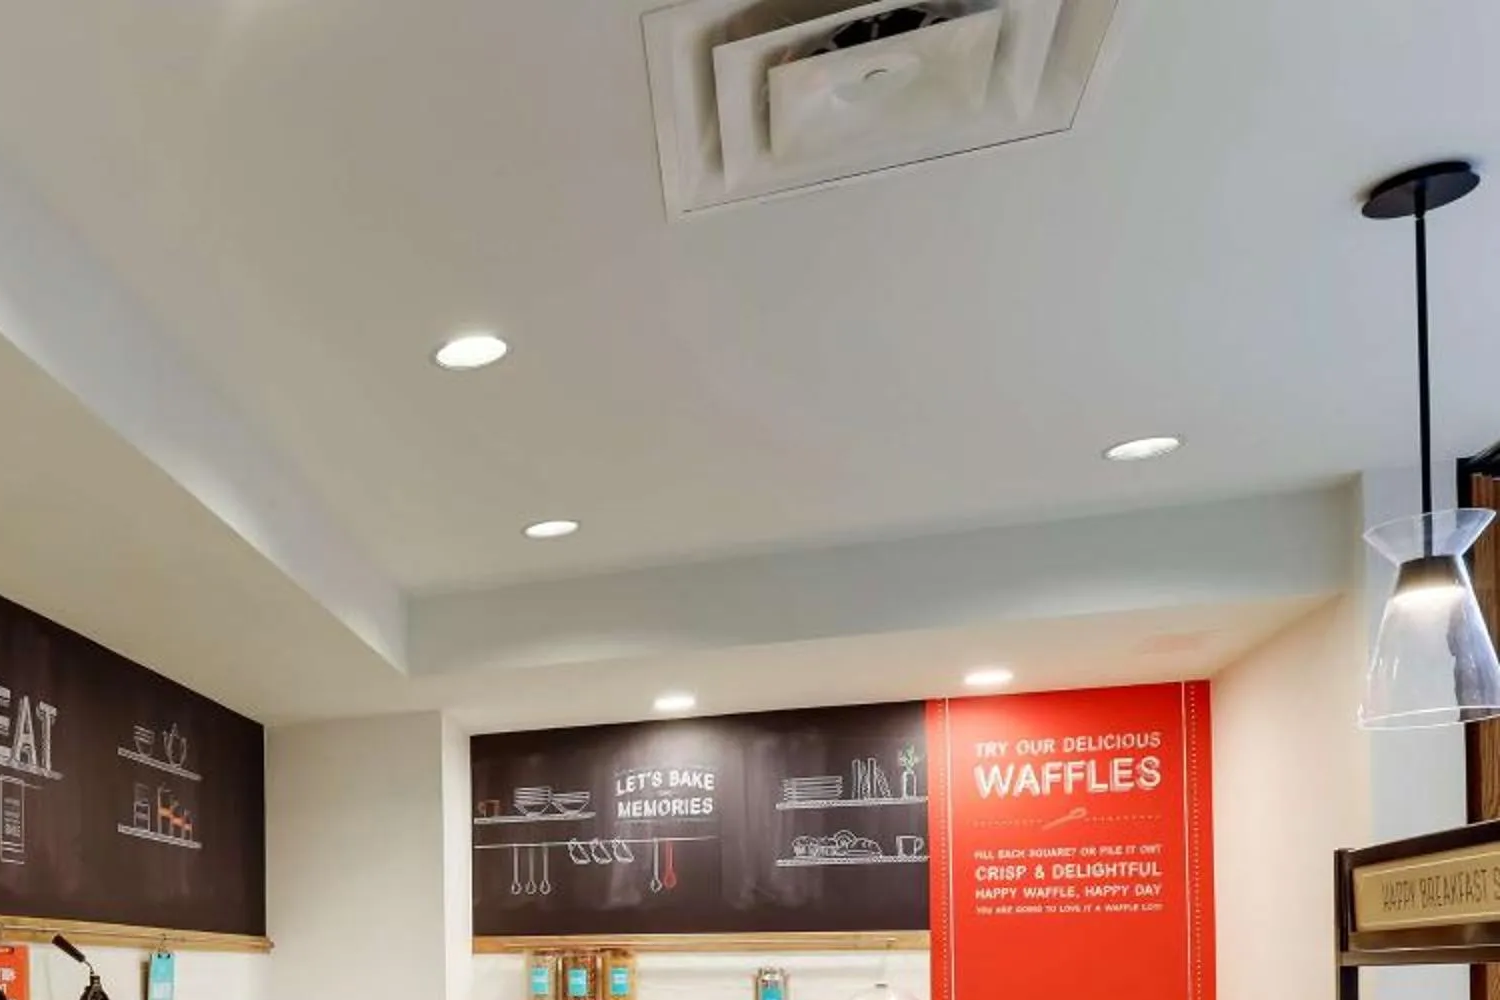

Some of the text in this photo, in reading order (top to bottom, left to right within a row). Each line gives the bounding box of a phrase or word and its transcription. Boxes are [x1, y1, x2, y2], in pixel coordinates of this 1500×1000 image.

[976, 731, 1162, 758] TRY OUR DELICIOUS
[615, 769, 715, 796] LET'S BAKE
[973, 756, 1162, 799] WAFFLES
[617, 797, 713, 818] MEMORIES
[975, 861, 1163, 881] CRISP & DELIGHTFUL
[975, 887, 1017, 899] HAPPY
[1085, 885, 1129, 897] HAPPY
[1134, 883, 1162, 896] DAY
[1419, 867, 1487, 908] BREAKFAST
